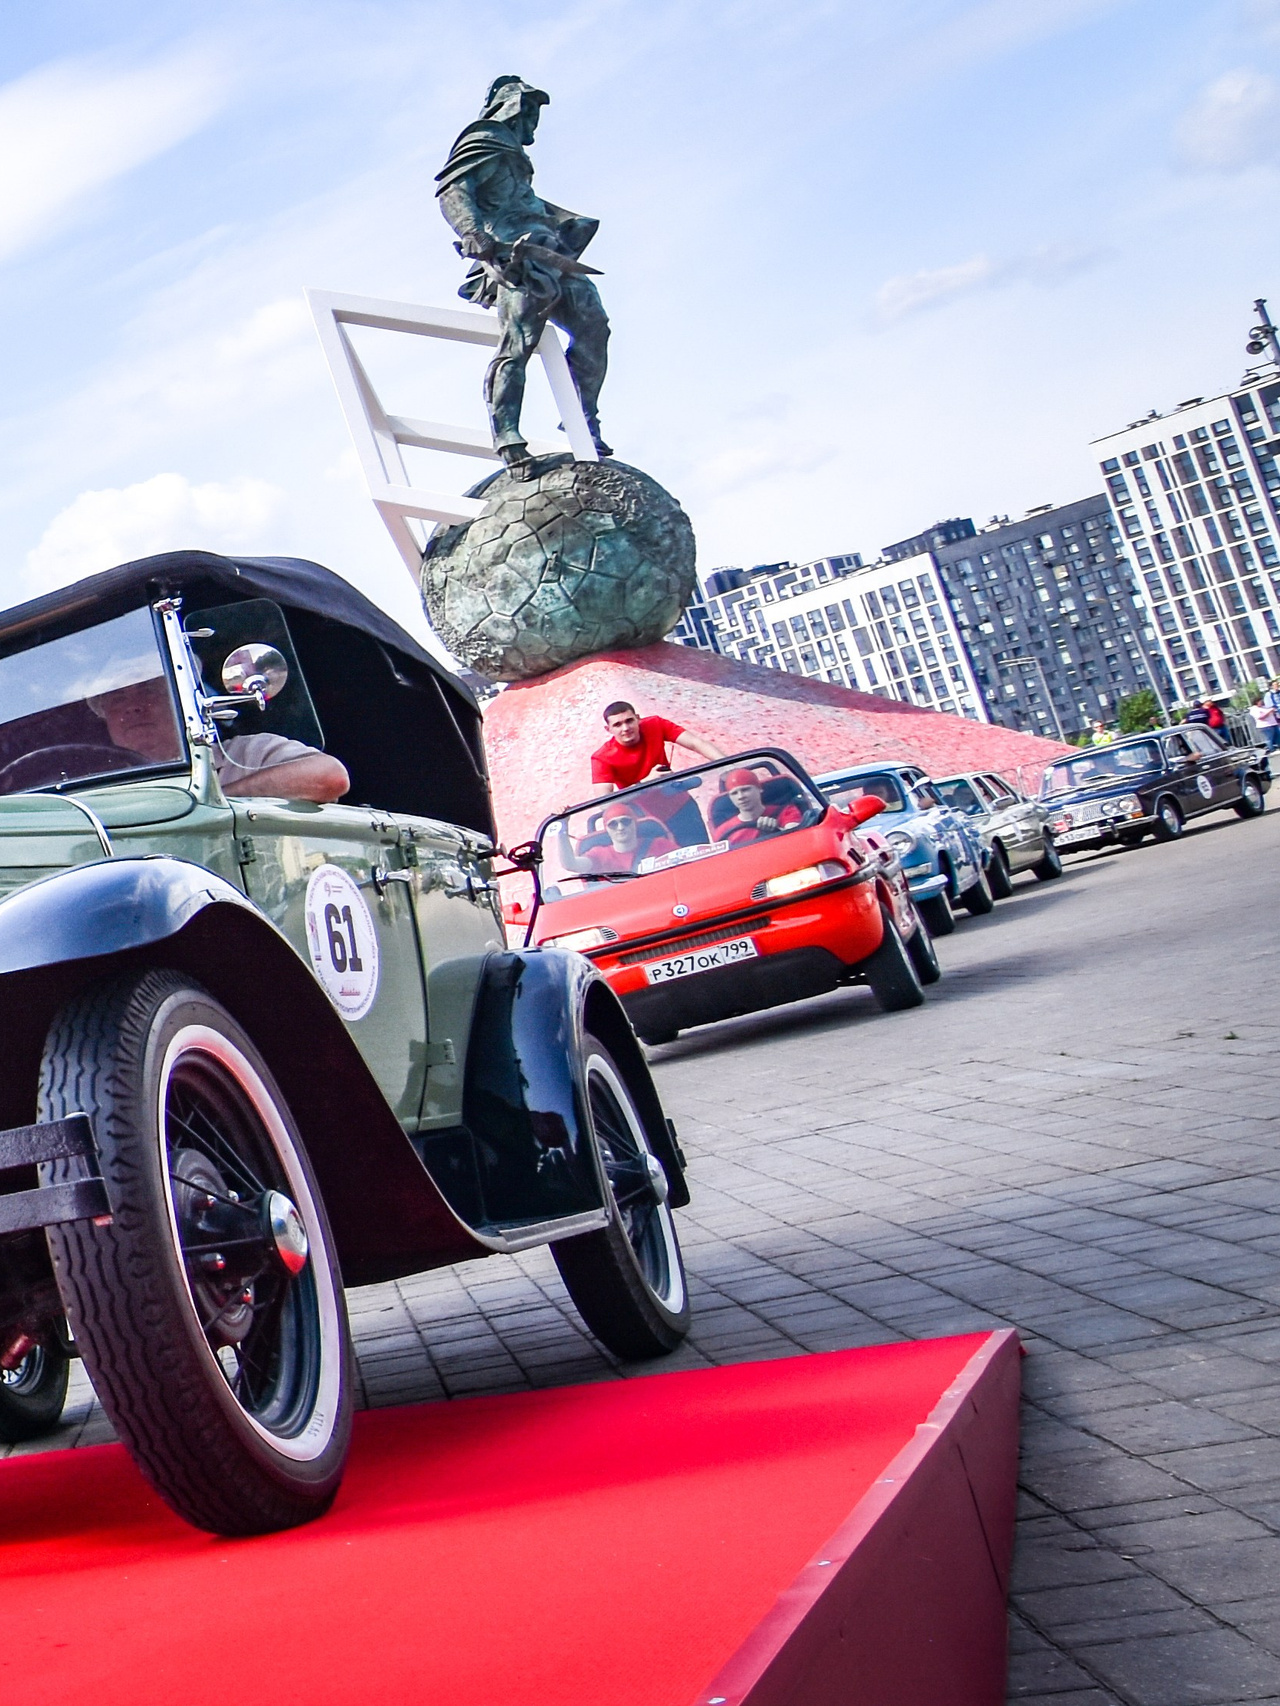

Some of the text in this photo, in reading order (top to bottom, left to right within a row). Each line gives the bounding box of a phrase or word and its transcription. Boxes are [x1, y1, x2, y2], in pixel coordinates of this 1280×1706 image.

[324, 903, 363, 973] 61
[652, 941, 749, 981] Р327ОК 799
